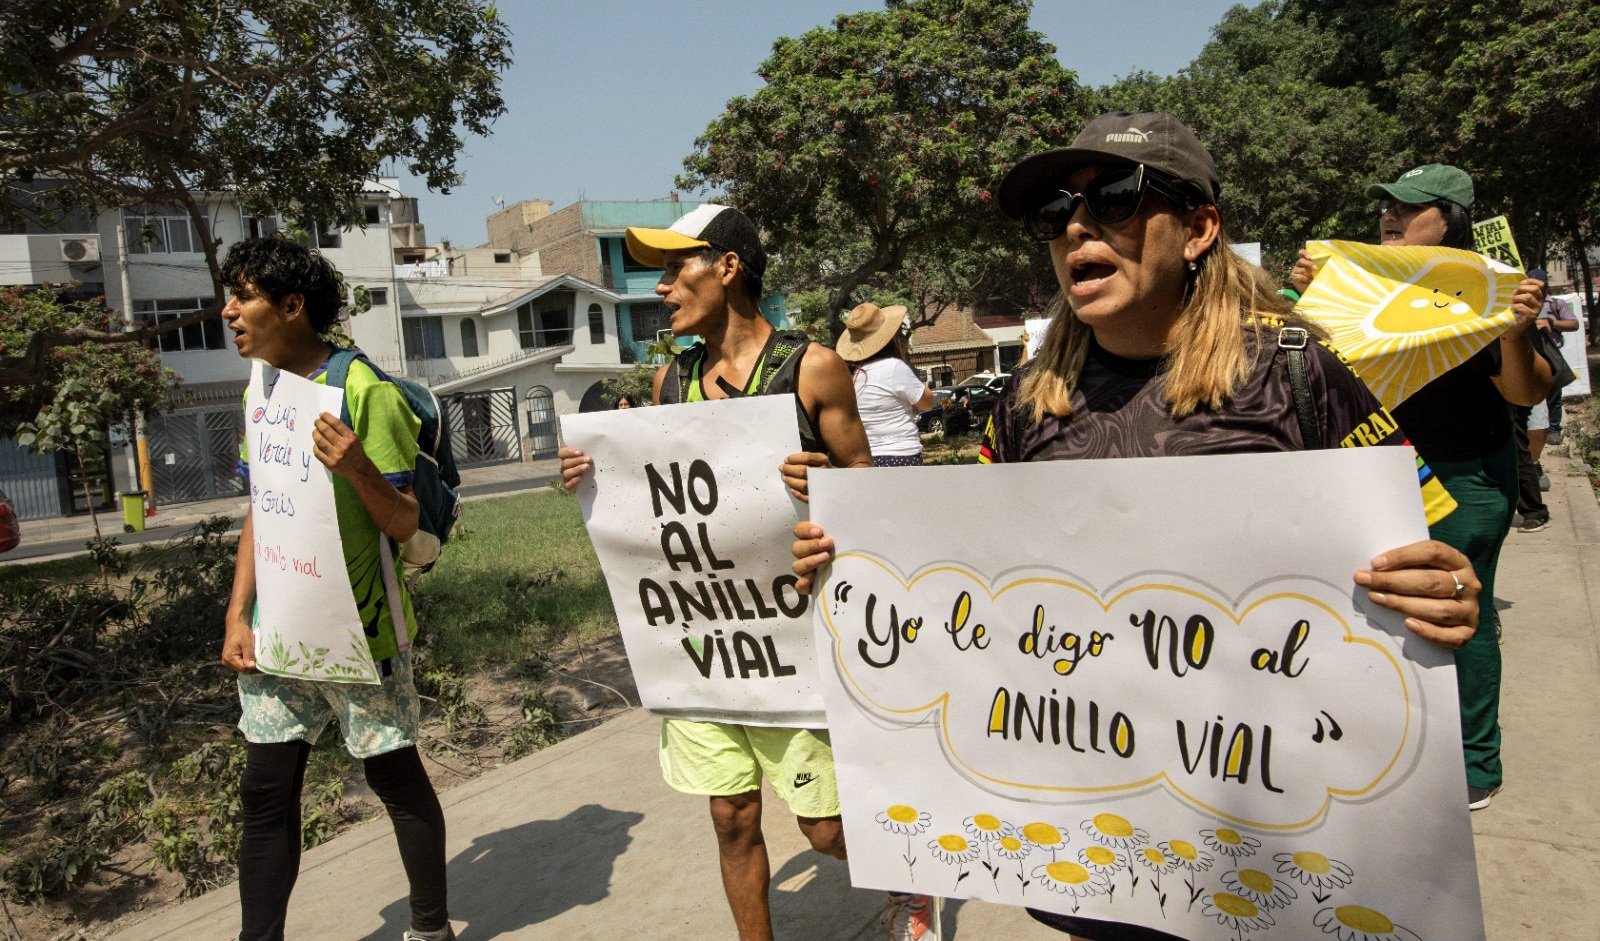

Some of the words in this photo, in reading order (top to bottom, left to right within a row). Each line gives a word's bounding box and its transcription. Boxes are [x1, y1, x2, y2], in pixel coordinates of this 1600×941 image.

[1105, 133, 1142, 143] PUMA
[645, 459, 718, 518] NO
[292, 555, 322, 578] vial
[660, 521, 735, 572] AL
[944, 590, 991, 651] le
[1018, 604, 1114, 676] digo
[1250, 619, 1310, 678] al
